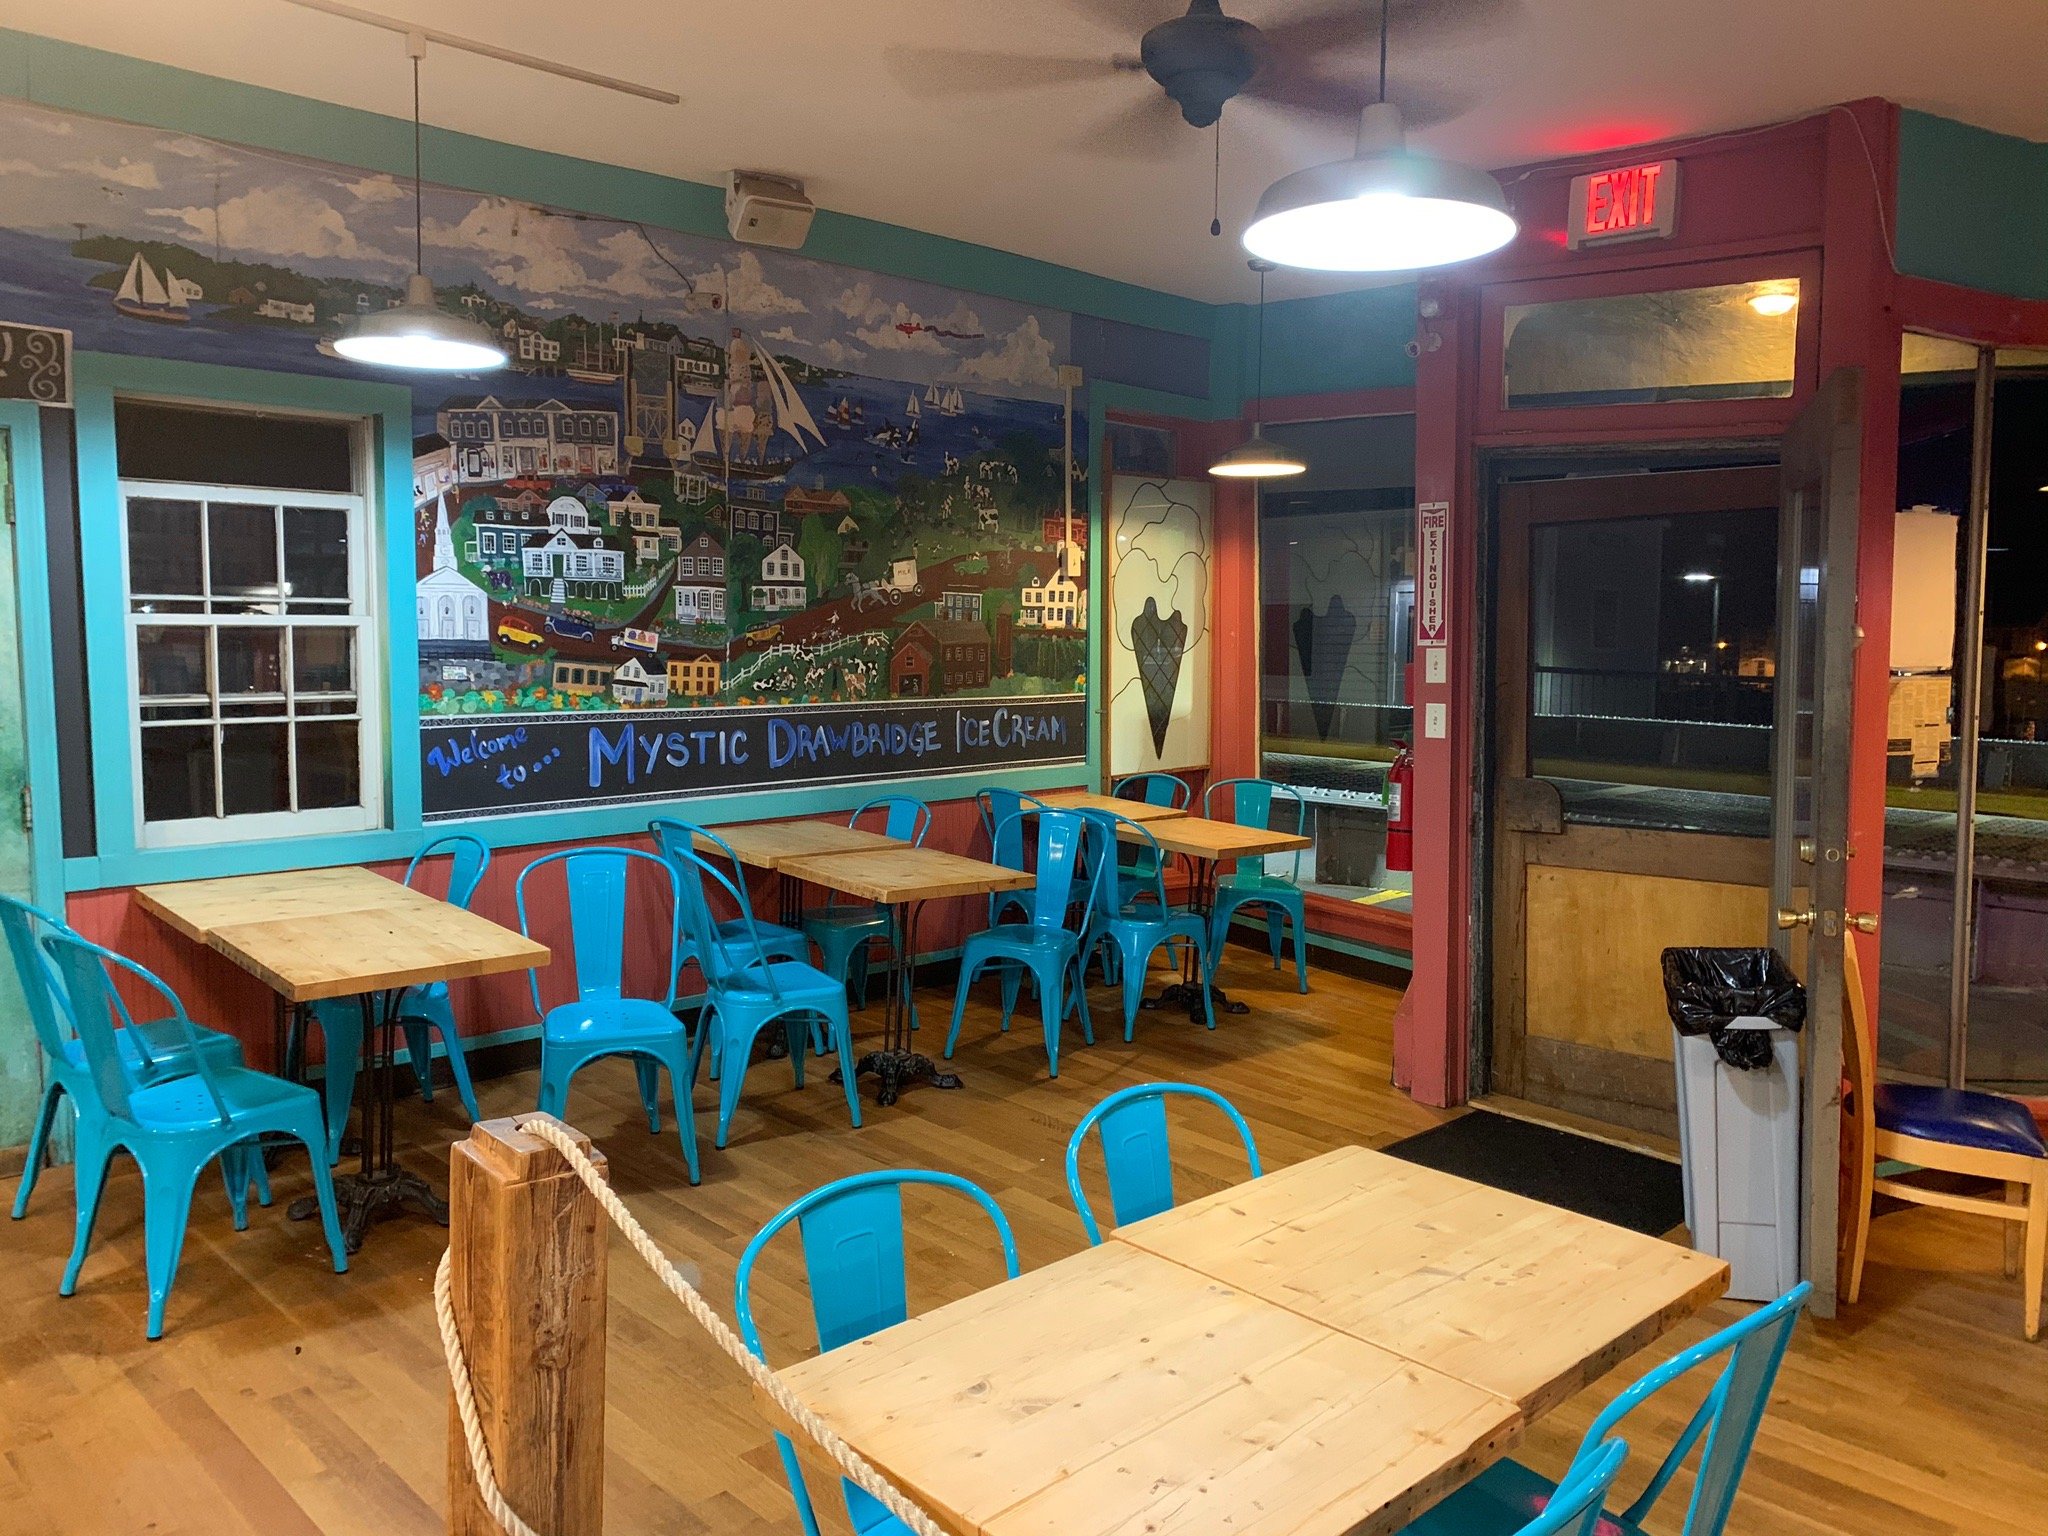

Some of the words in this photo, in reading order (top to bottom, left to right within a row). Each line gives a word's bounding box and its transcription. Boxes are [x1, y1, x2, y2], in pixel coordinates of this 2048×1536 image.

[1587, 165, 1661, 233] EXIT
[1423, 515, 1445, 529] FIRE
[1429, 530, 1438, 632] EXTINGUISHER
[427, 727, 529, 777] Welcome
